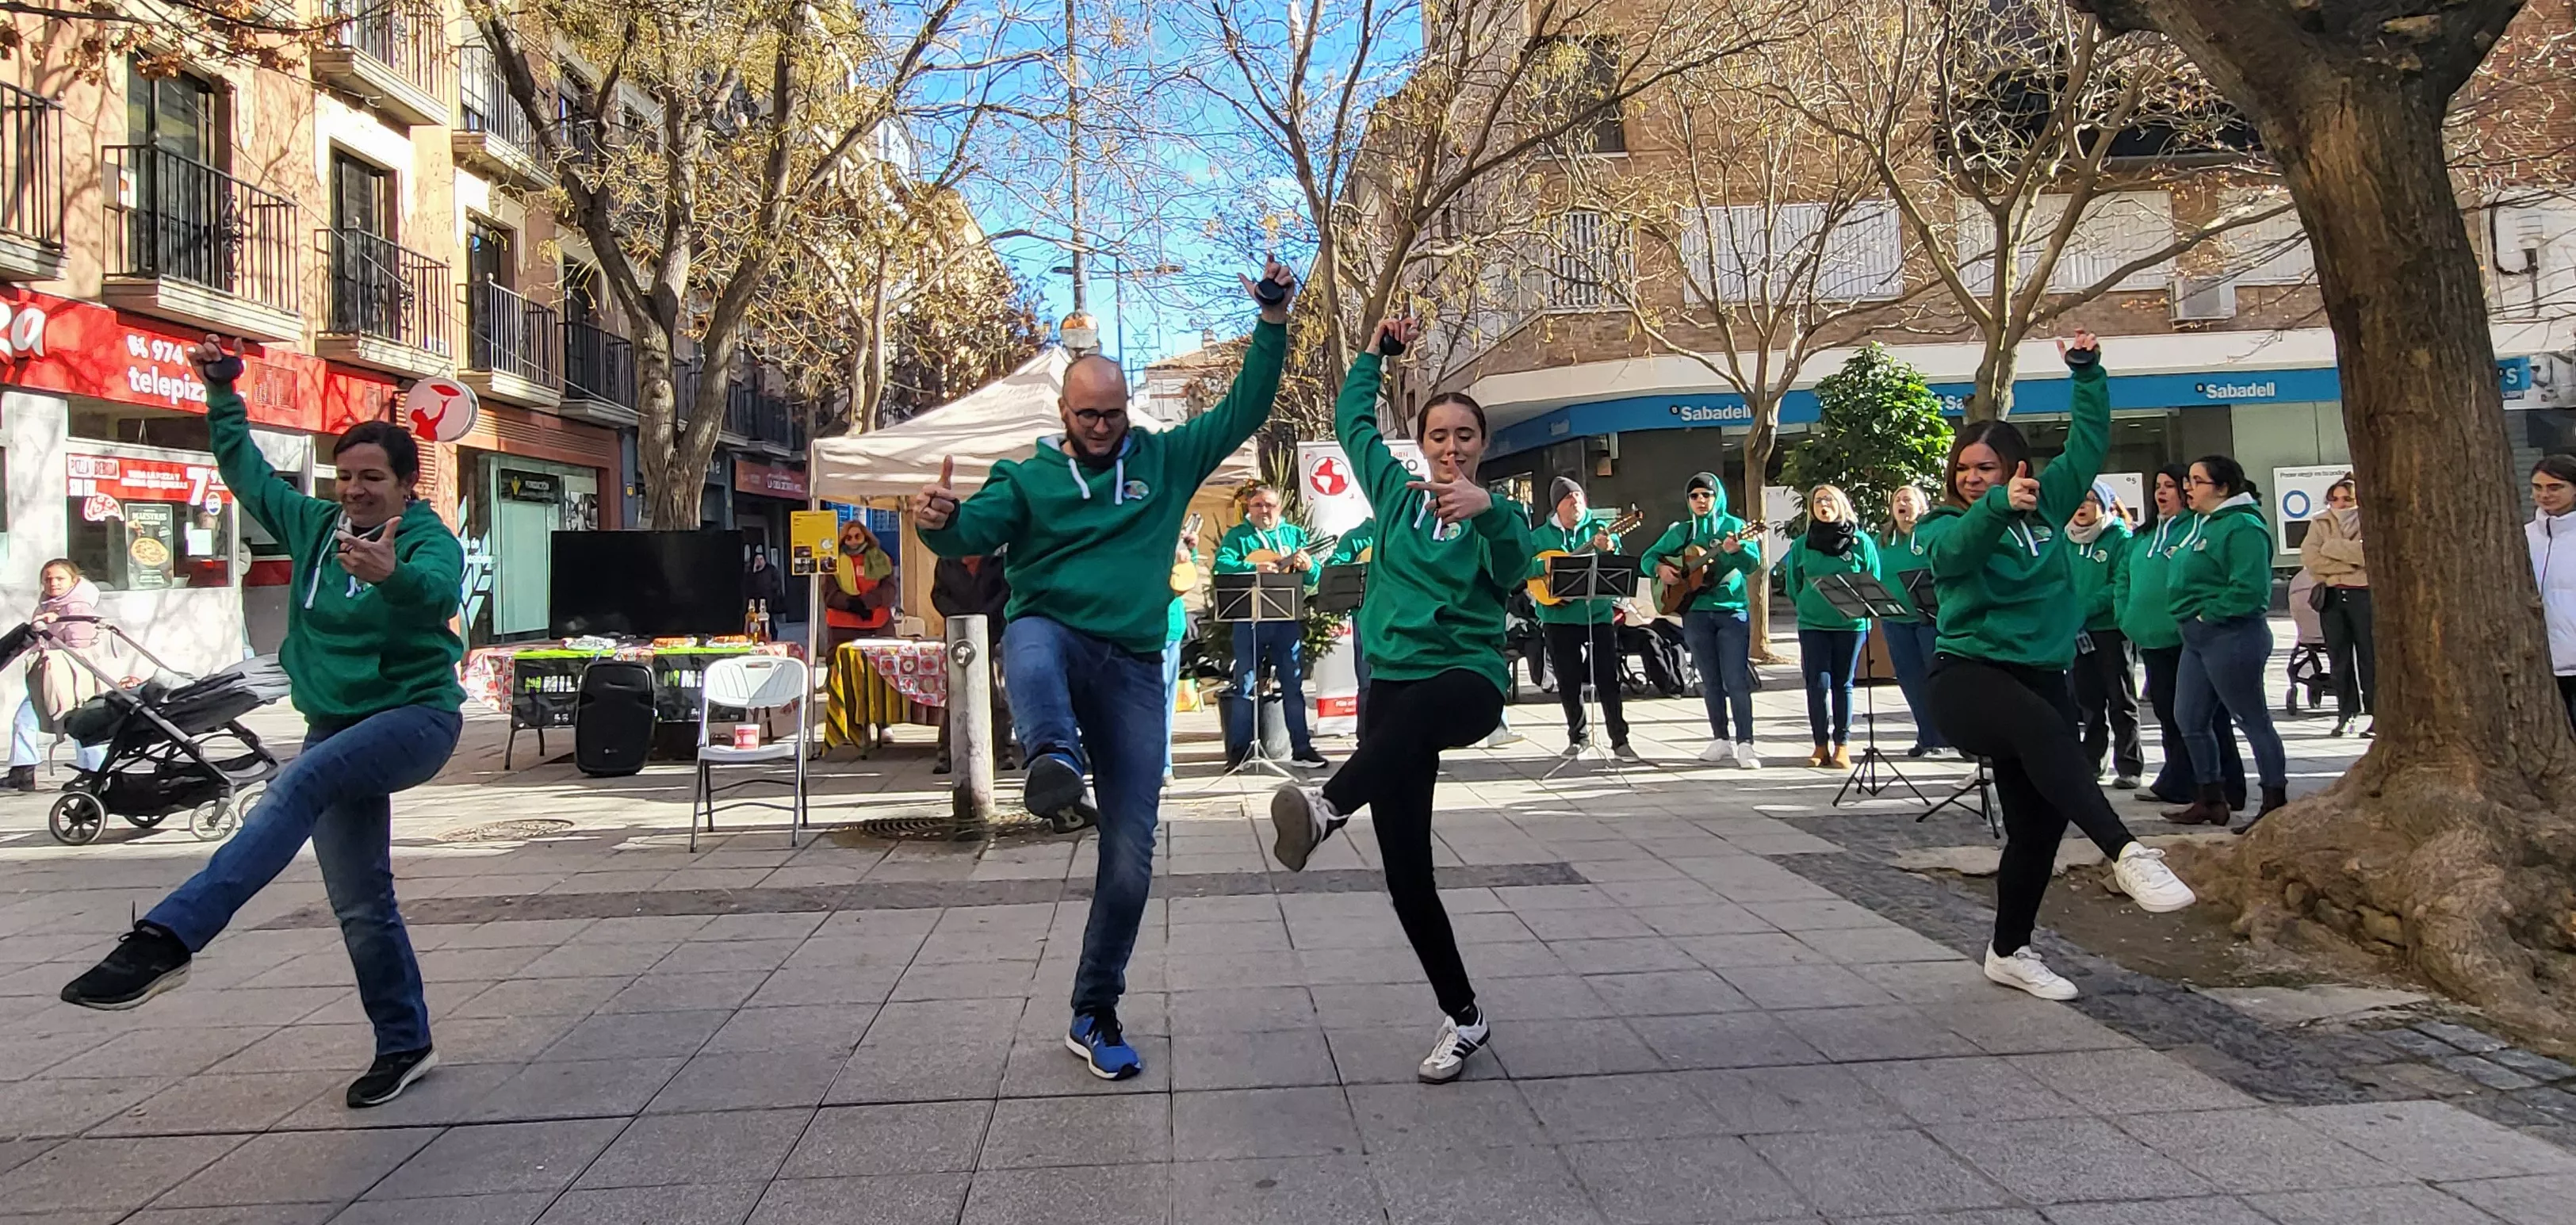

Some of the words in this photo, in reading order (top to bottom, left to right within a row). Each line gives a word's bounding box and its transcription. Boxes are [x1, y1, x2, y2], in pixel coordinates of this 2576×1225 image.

[151, 339, 185, 366] 974
[128, 365, 207, 405] telepiz
[2206, 381, 2276, 399] Sabadell
[1681, 404, 1751, 422] Sabadell
